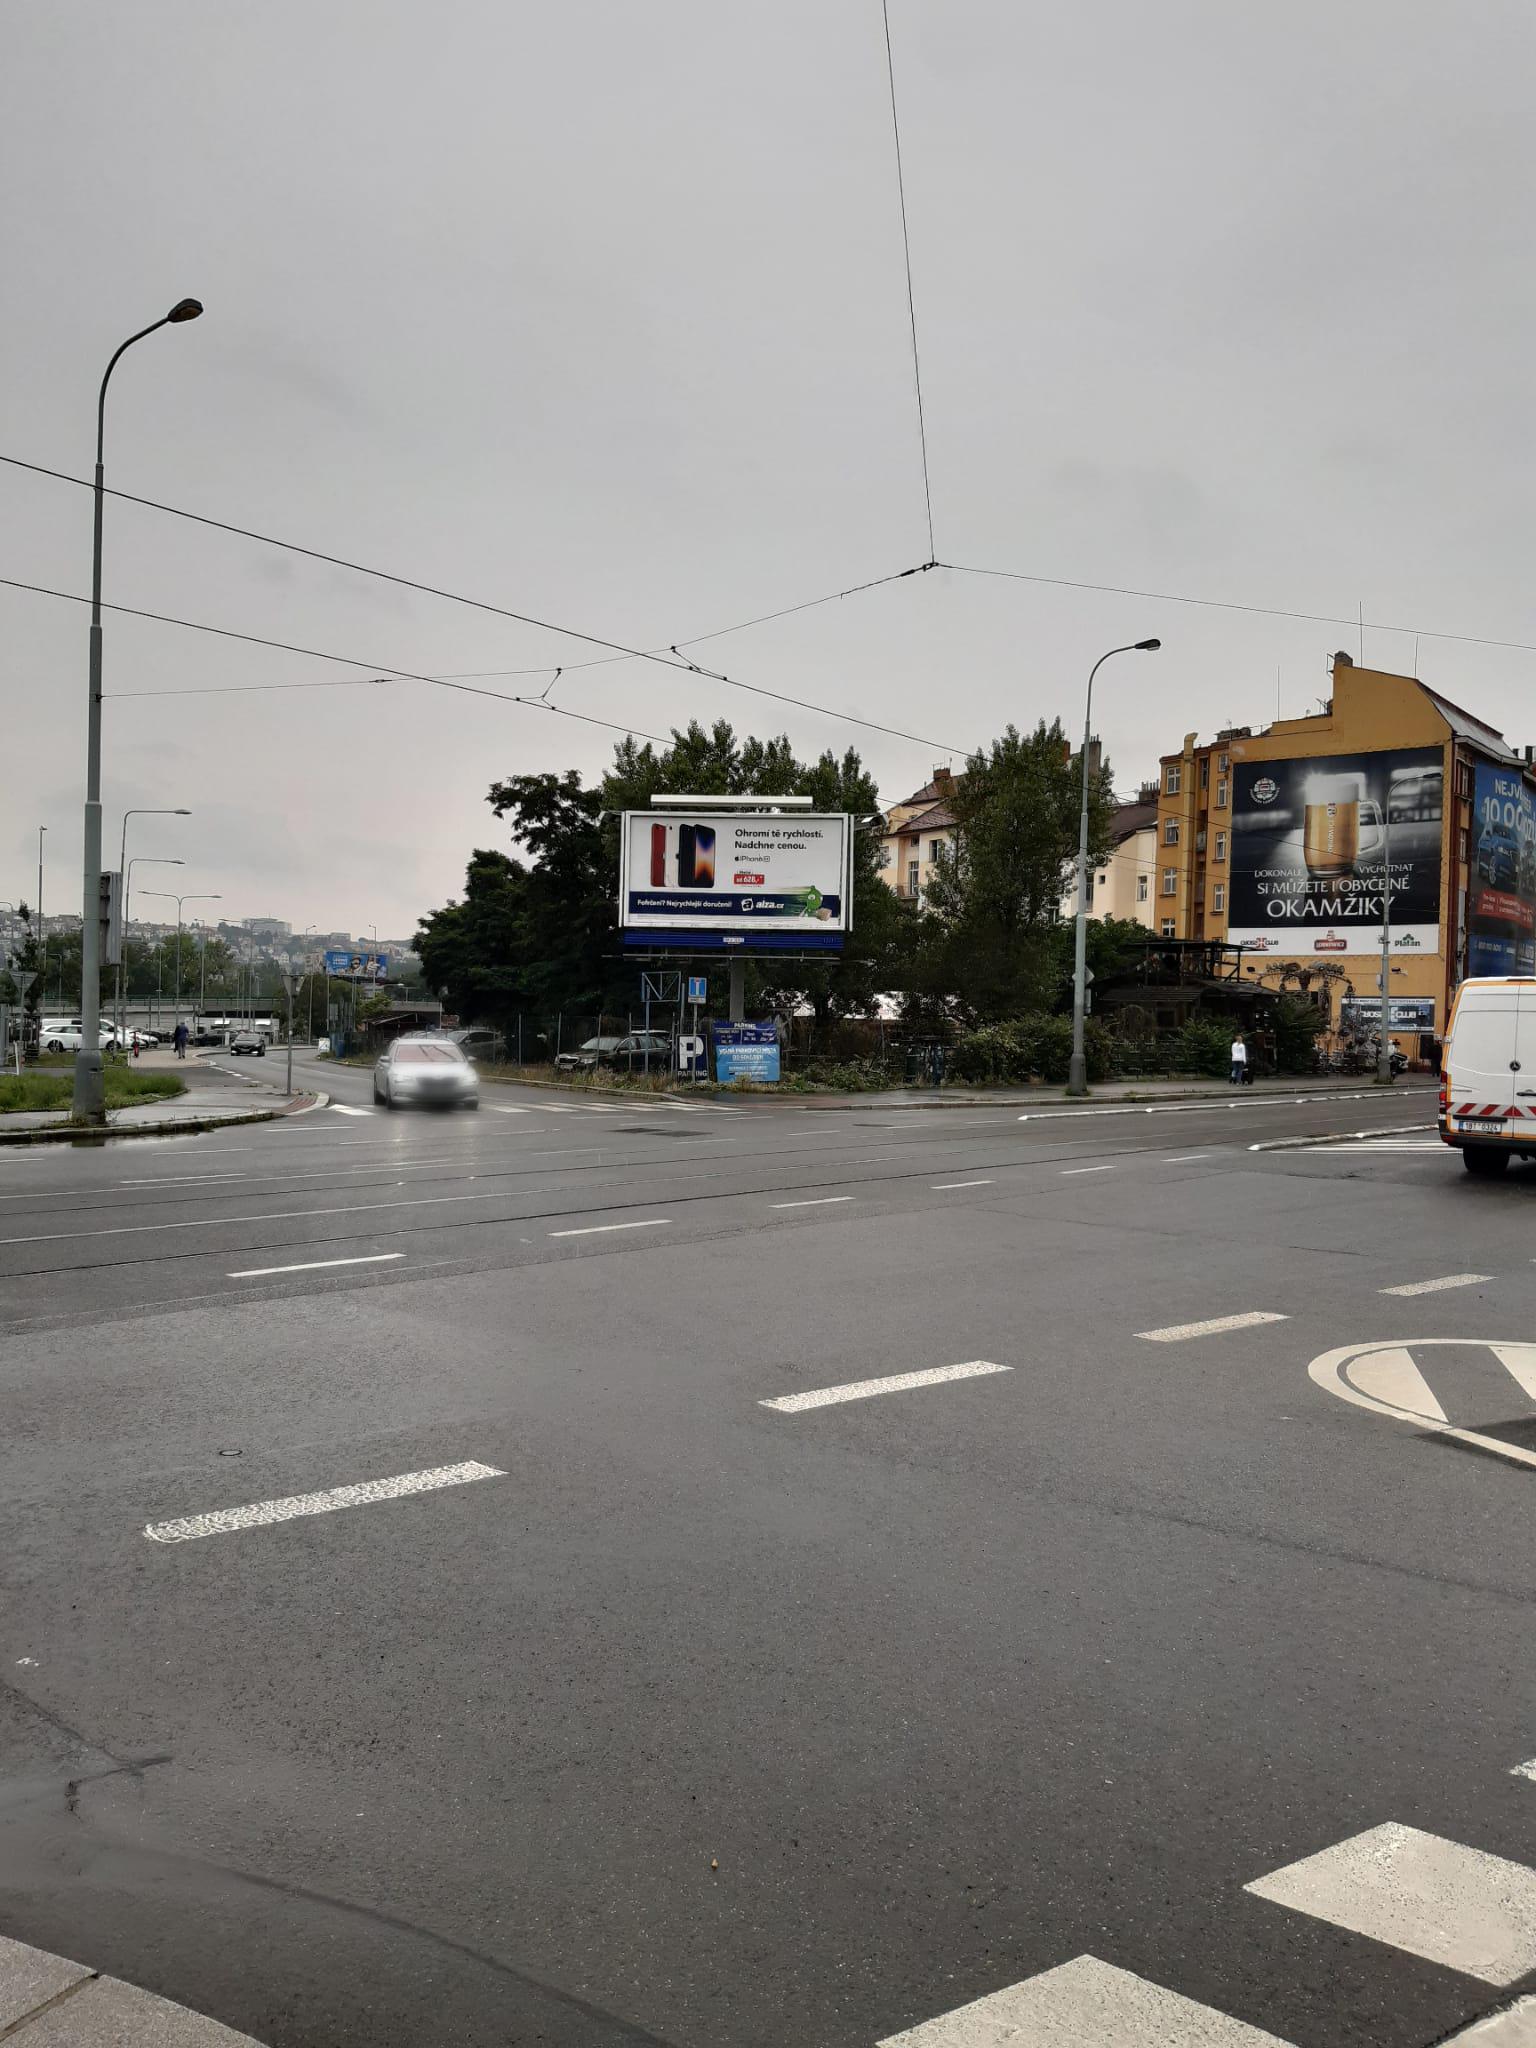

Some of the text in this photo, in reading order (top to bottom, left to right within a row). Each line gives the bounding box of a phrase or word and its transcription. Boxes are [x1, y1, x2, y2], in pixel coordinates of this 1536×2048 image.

[735, 828, 824, 840] Ohromí tě rychlostí.
[735, 841, 807, 850] Nadchne cenou.
[1257, 882, 1268, 895] SI
[1272, 877, 1328, 895] MŮŽETE
[1339, 874, 1410, 893] OBYČENÉ
[1266, 893, 1395, 918] OKAMŽIKY
[679, 1036, 704, 1069] P
